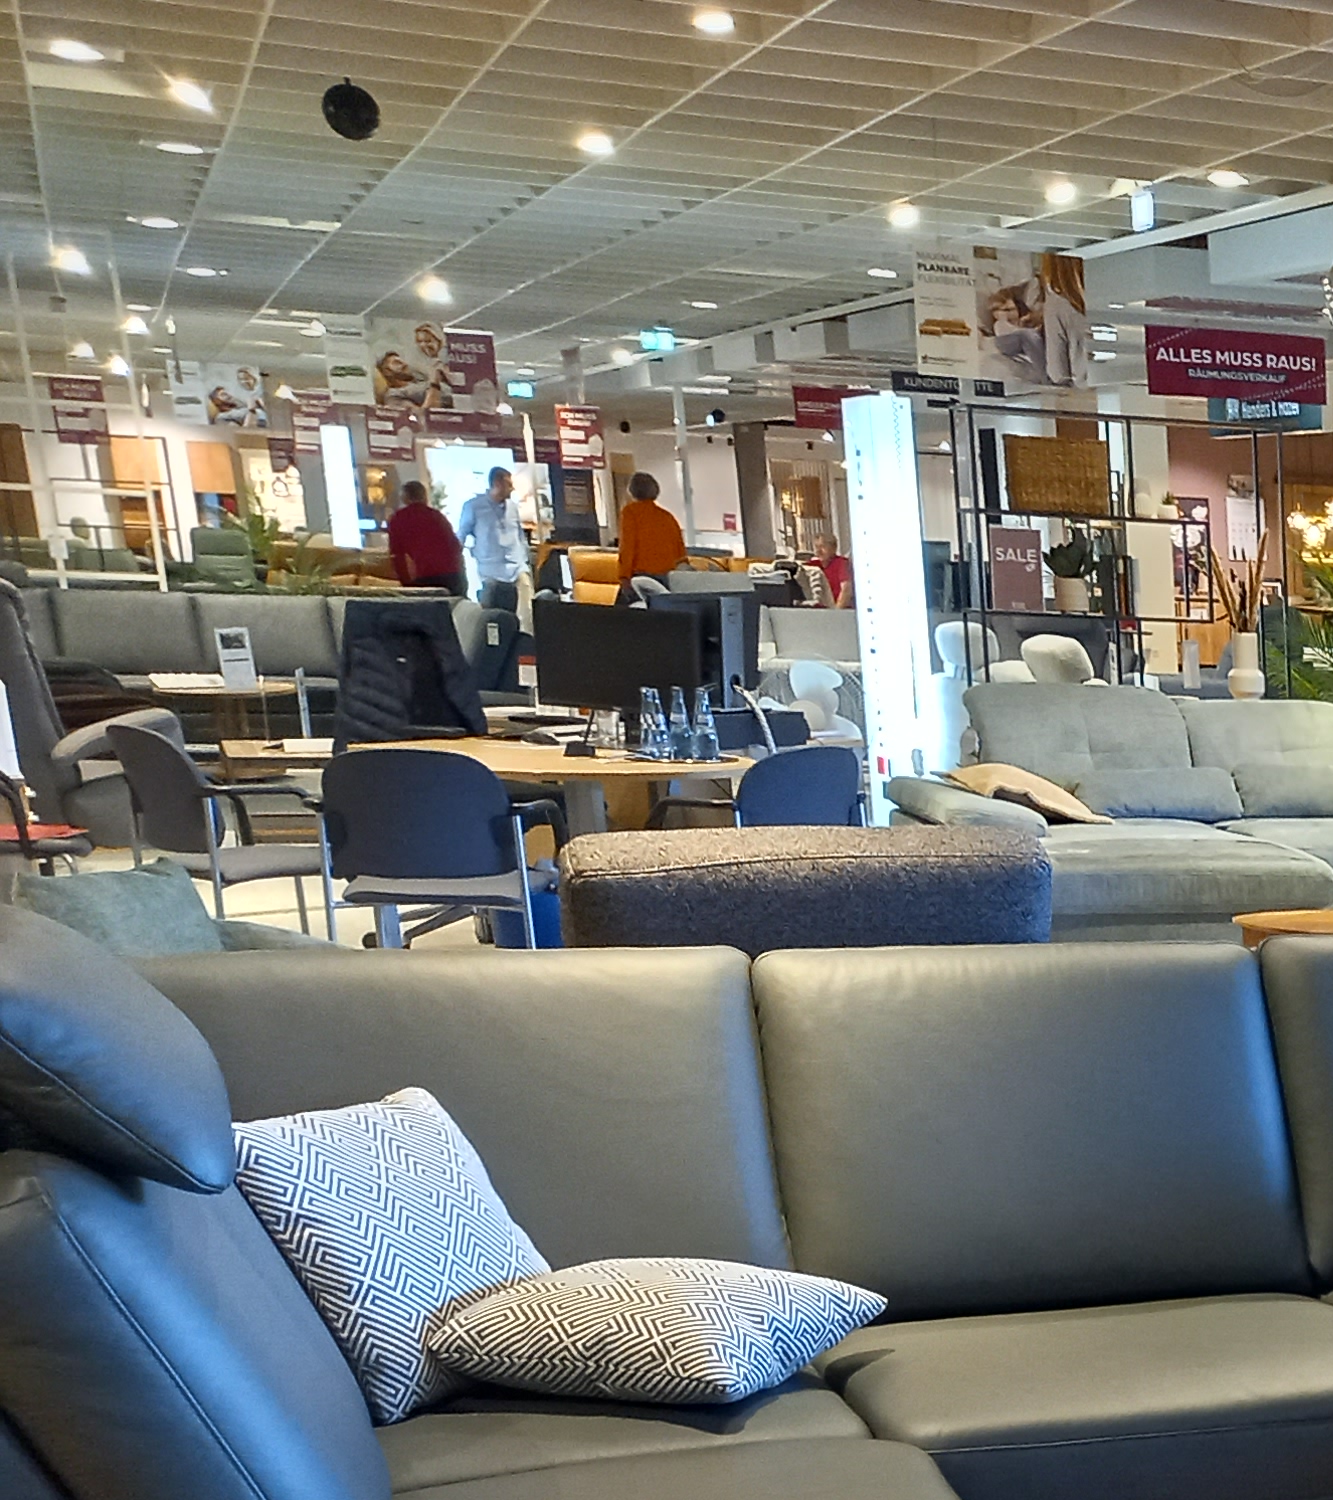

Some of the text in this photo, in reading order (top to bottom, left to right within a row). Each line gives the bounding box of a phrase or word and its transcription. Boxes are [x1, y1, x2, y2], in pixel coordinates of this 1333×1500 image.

[1156, 347, 1316, 372] ALLES MUSS RAUS!
[995, 547, 1038, 563] SALE
